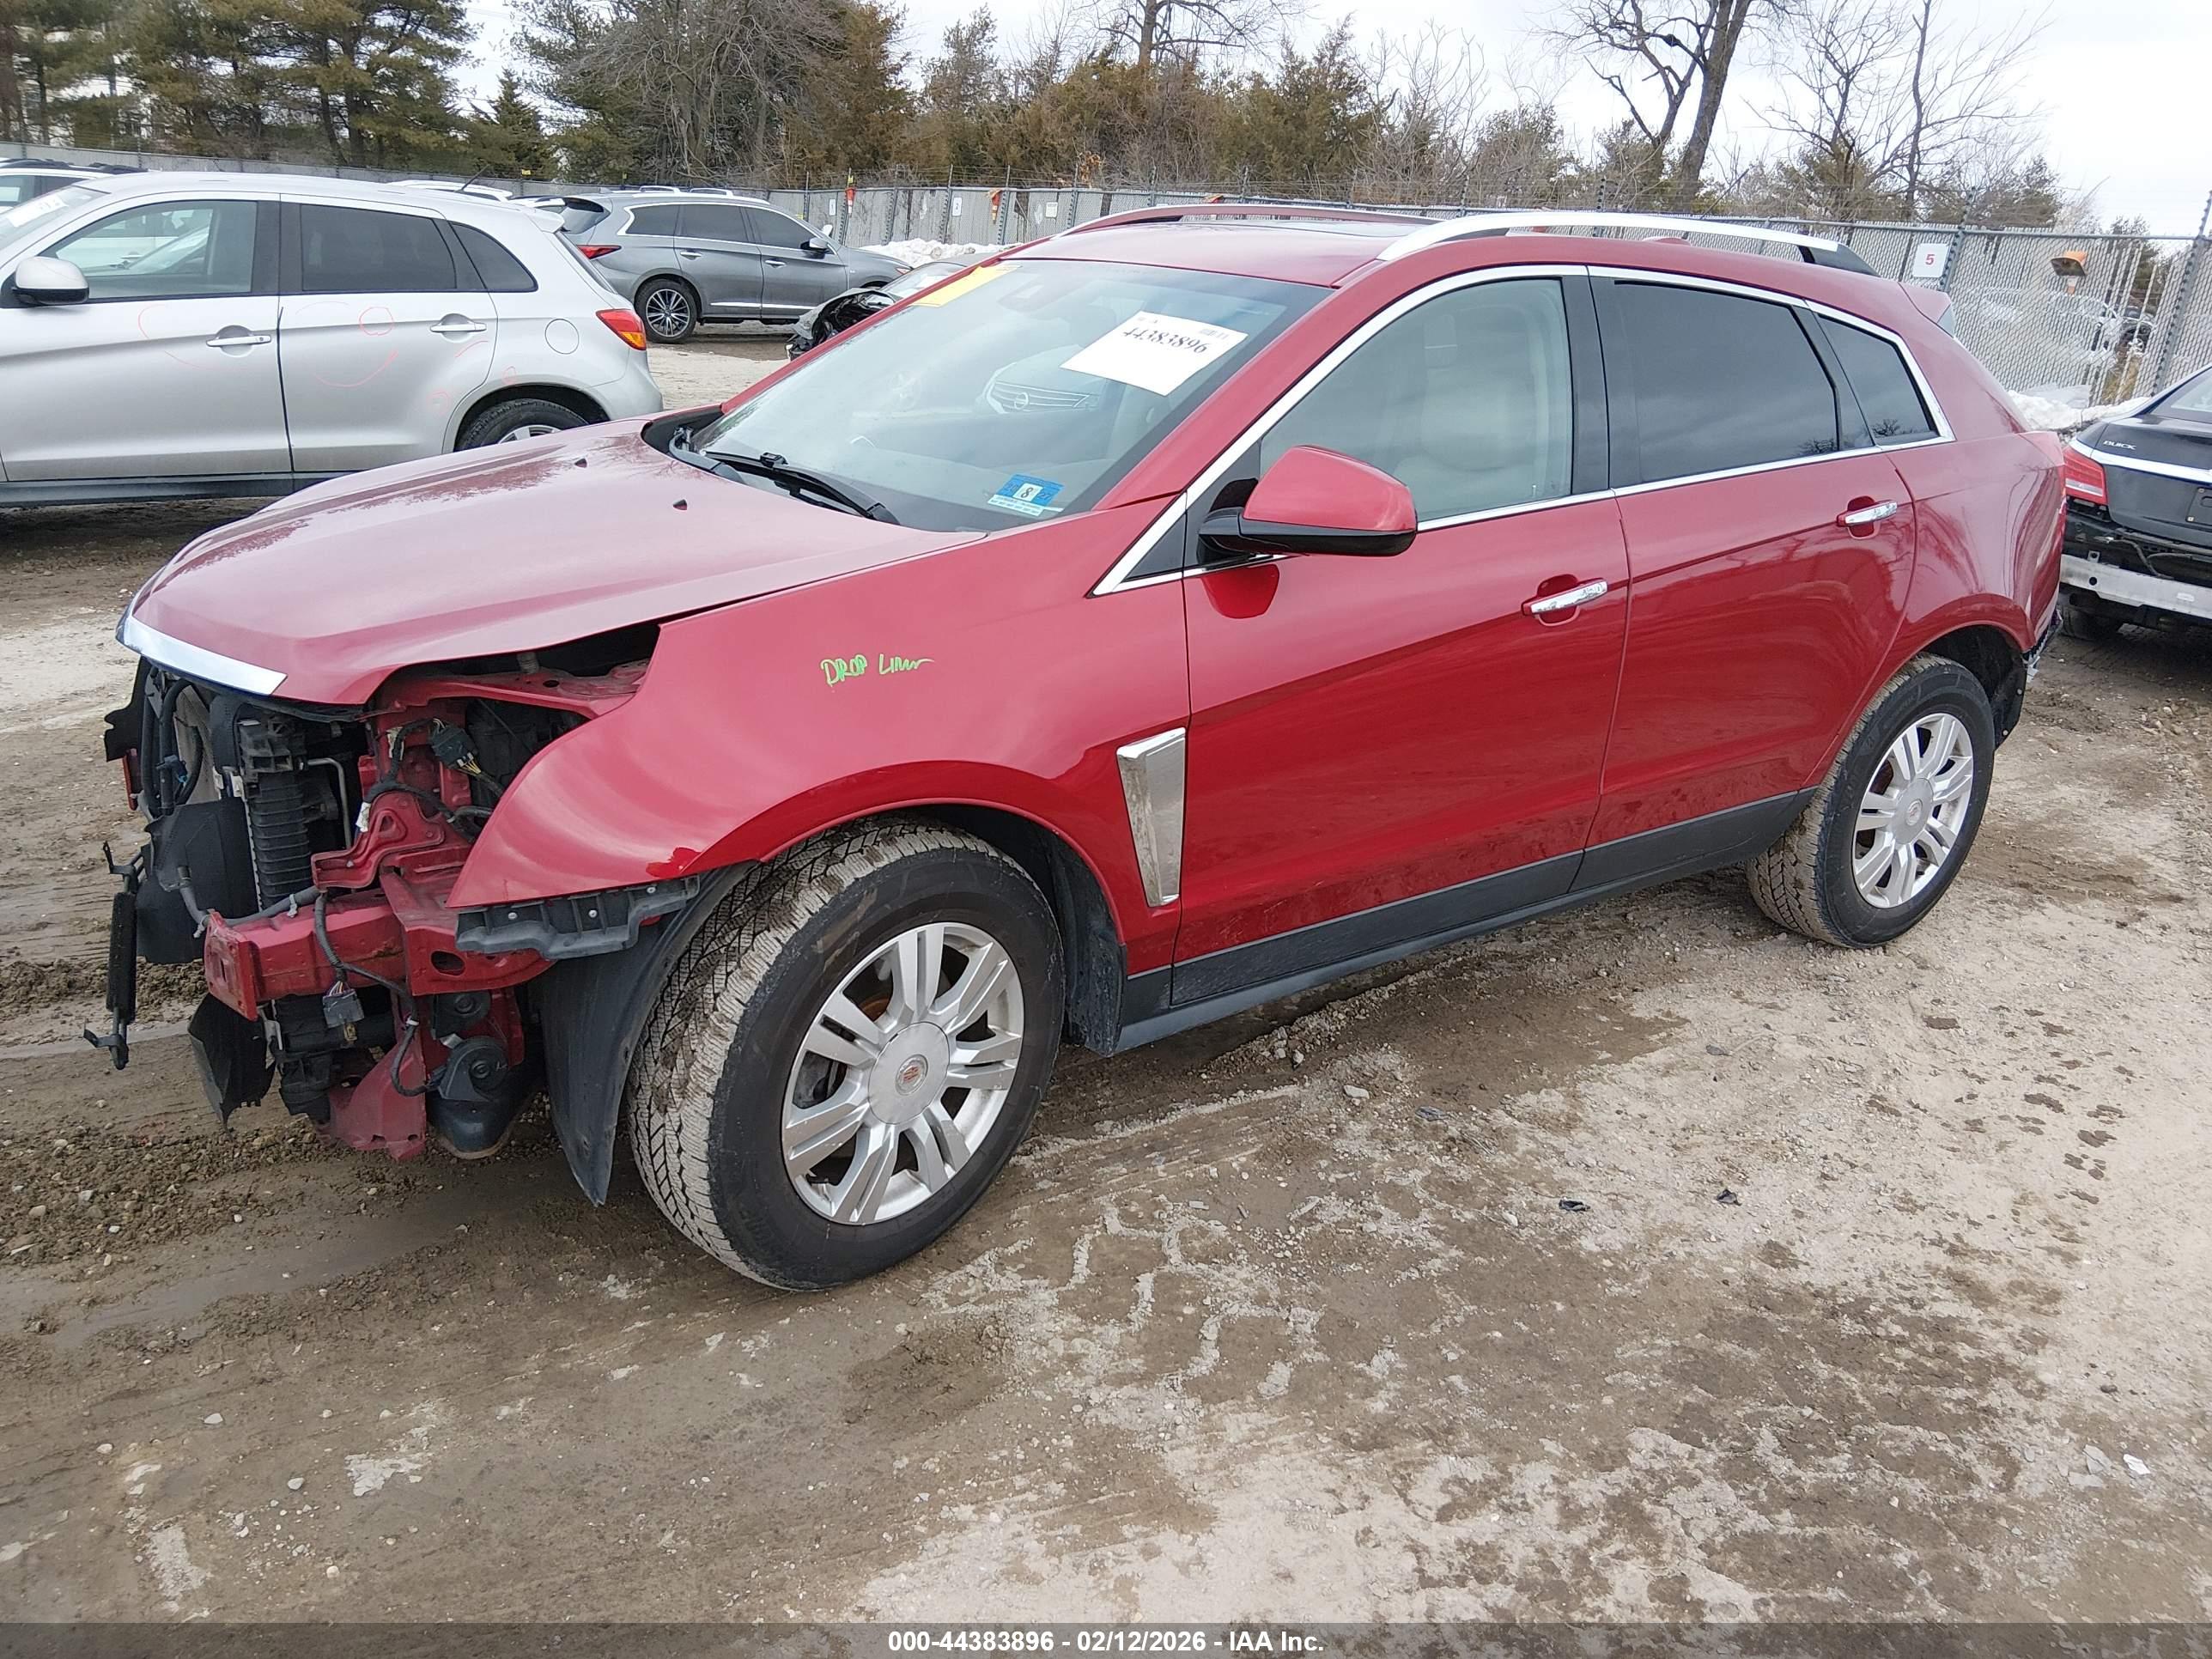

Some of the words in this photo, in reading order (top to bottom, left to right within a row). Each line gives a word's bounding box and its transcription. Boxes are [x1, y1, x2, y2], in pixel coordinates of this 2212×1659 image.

[1925, 253, 1936, 265] 5
[1123, 327, 1207, 354] 44383896
[2103, 440, 2136, 450] BUICK
[1020, 487, 1034, 498] 8
[820, 653, 868, 688] DROP
